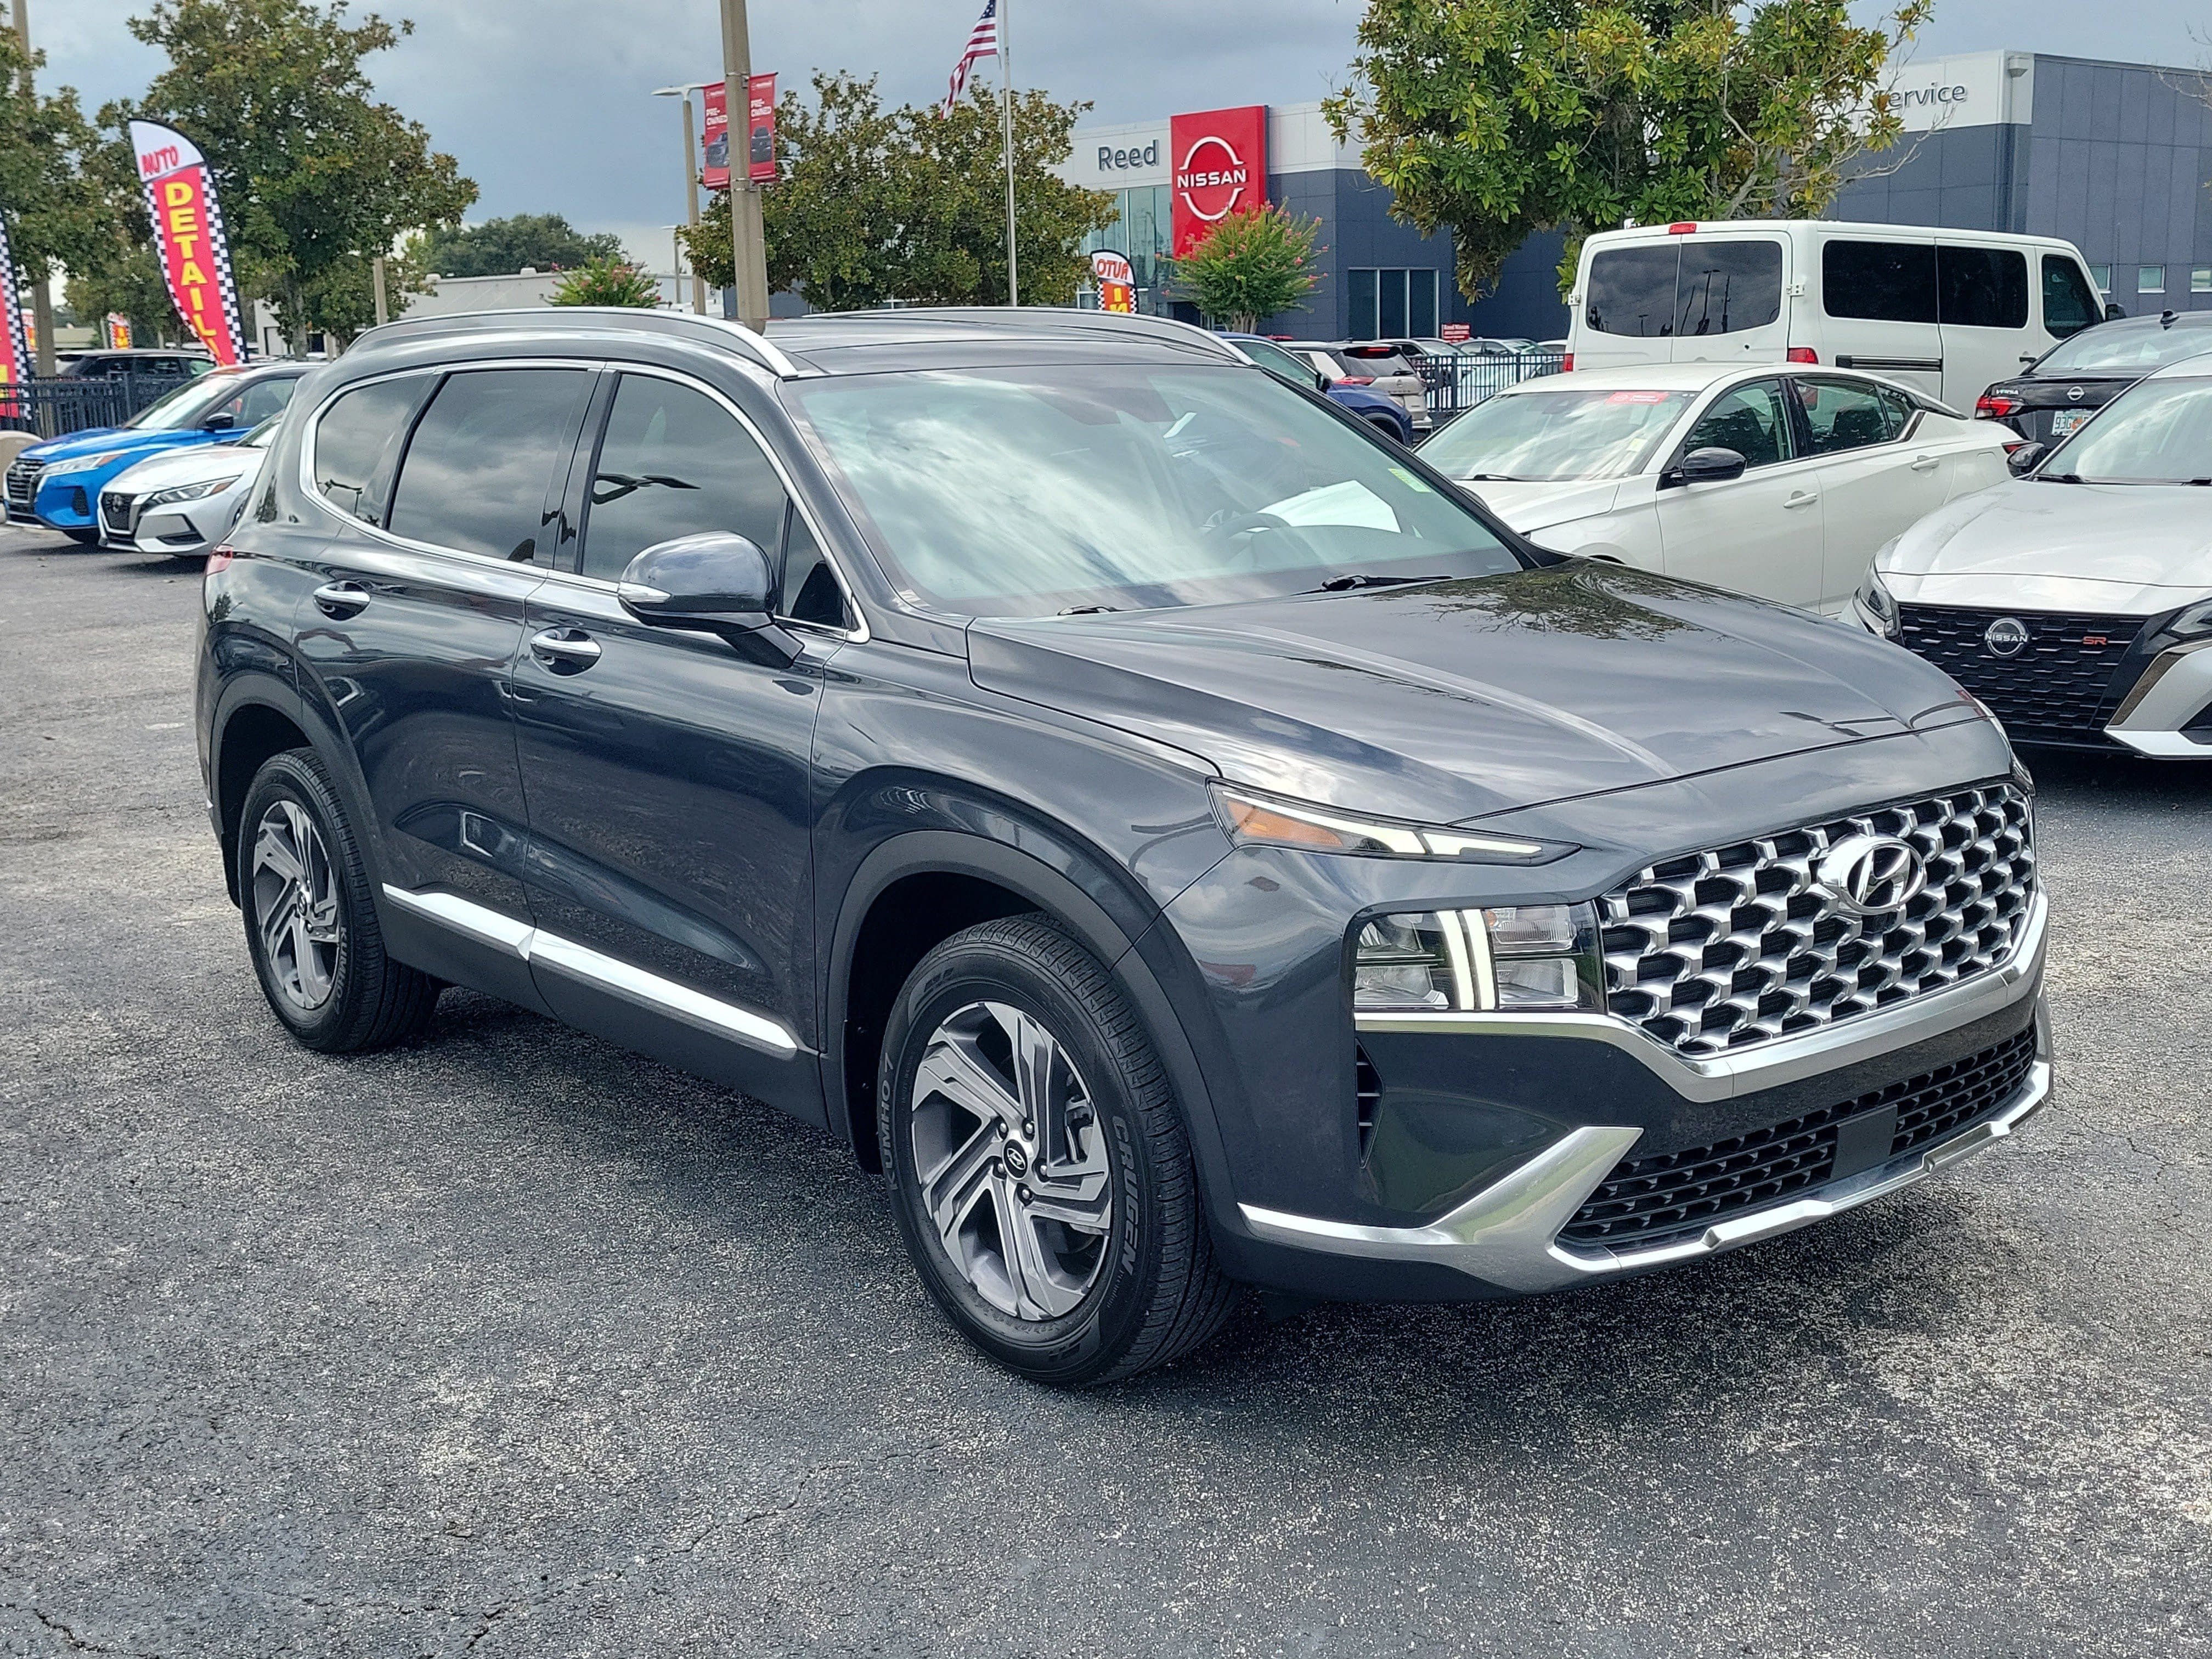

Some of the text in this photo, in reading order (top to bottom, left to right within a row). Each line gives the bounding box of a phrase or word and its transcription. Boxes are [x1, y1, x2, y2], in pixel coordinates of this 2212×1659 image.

[1874, 82, 1966, 108] ervice
[142, 145, 178, 177] AUTO
[1098, 139, 1158, 171] Reed
[1177, 168, 1246, 189] NISSAN
[1984, 633, 2028, 643] NISSAN
[2083, 636, 2107, 645] SR
[337, 927, 347, 998] KUMHO
[881, 1080, 898, 1190] KUMHO
[1113, 1116, 1138, 1276] CRUGEN
